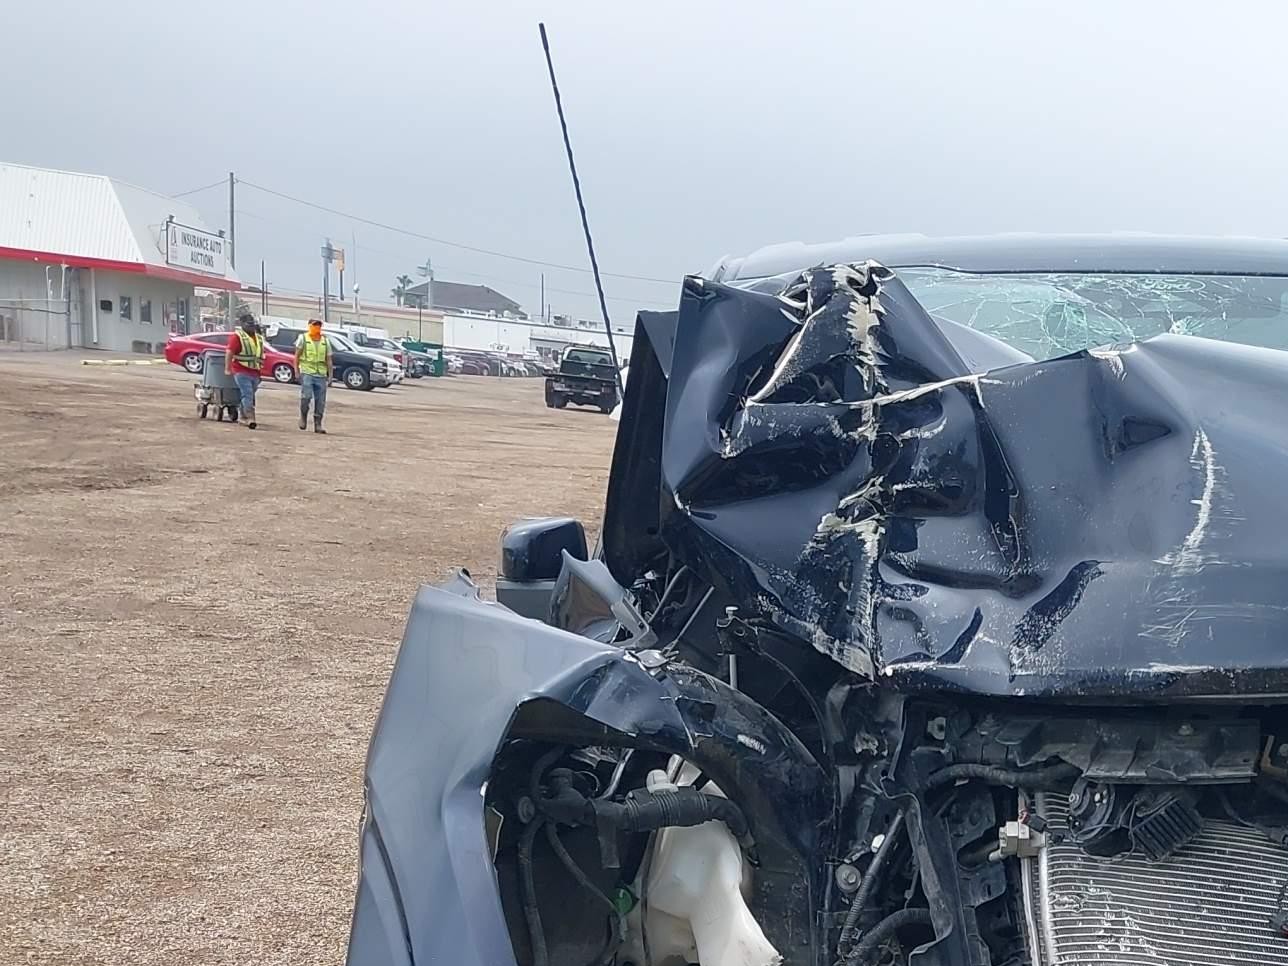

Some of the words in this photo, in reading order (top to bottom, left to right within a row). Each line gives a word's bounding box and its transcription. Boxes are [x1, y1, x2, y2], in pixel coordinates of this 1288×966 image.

[181, 232, 209, 251] INSURANCE
[210, 240, 221, 254] AUTO
[191, 250, 214, 267] AUCTIONS
